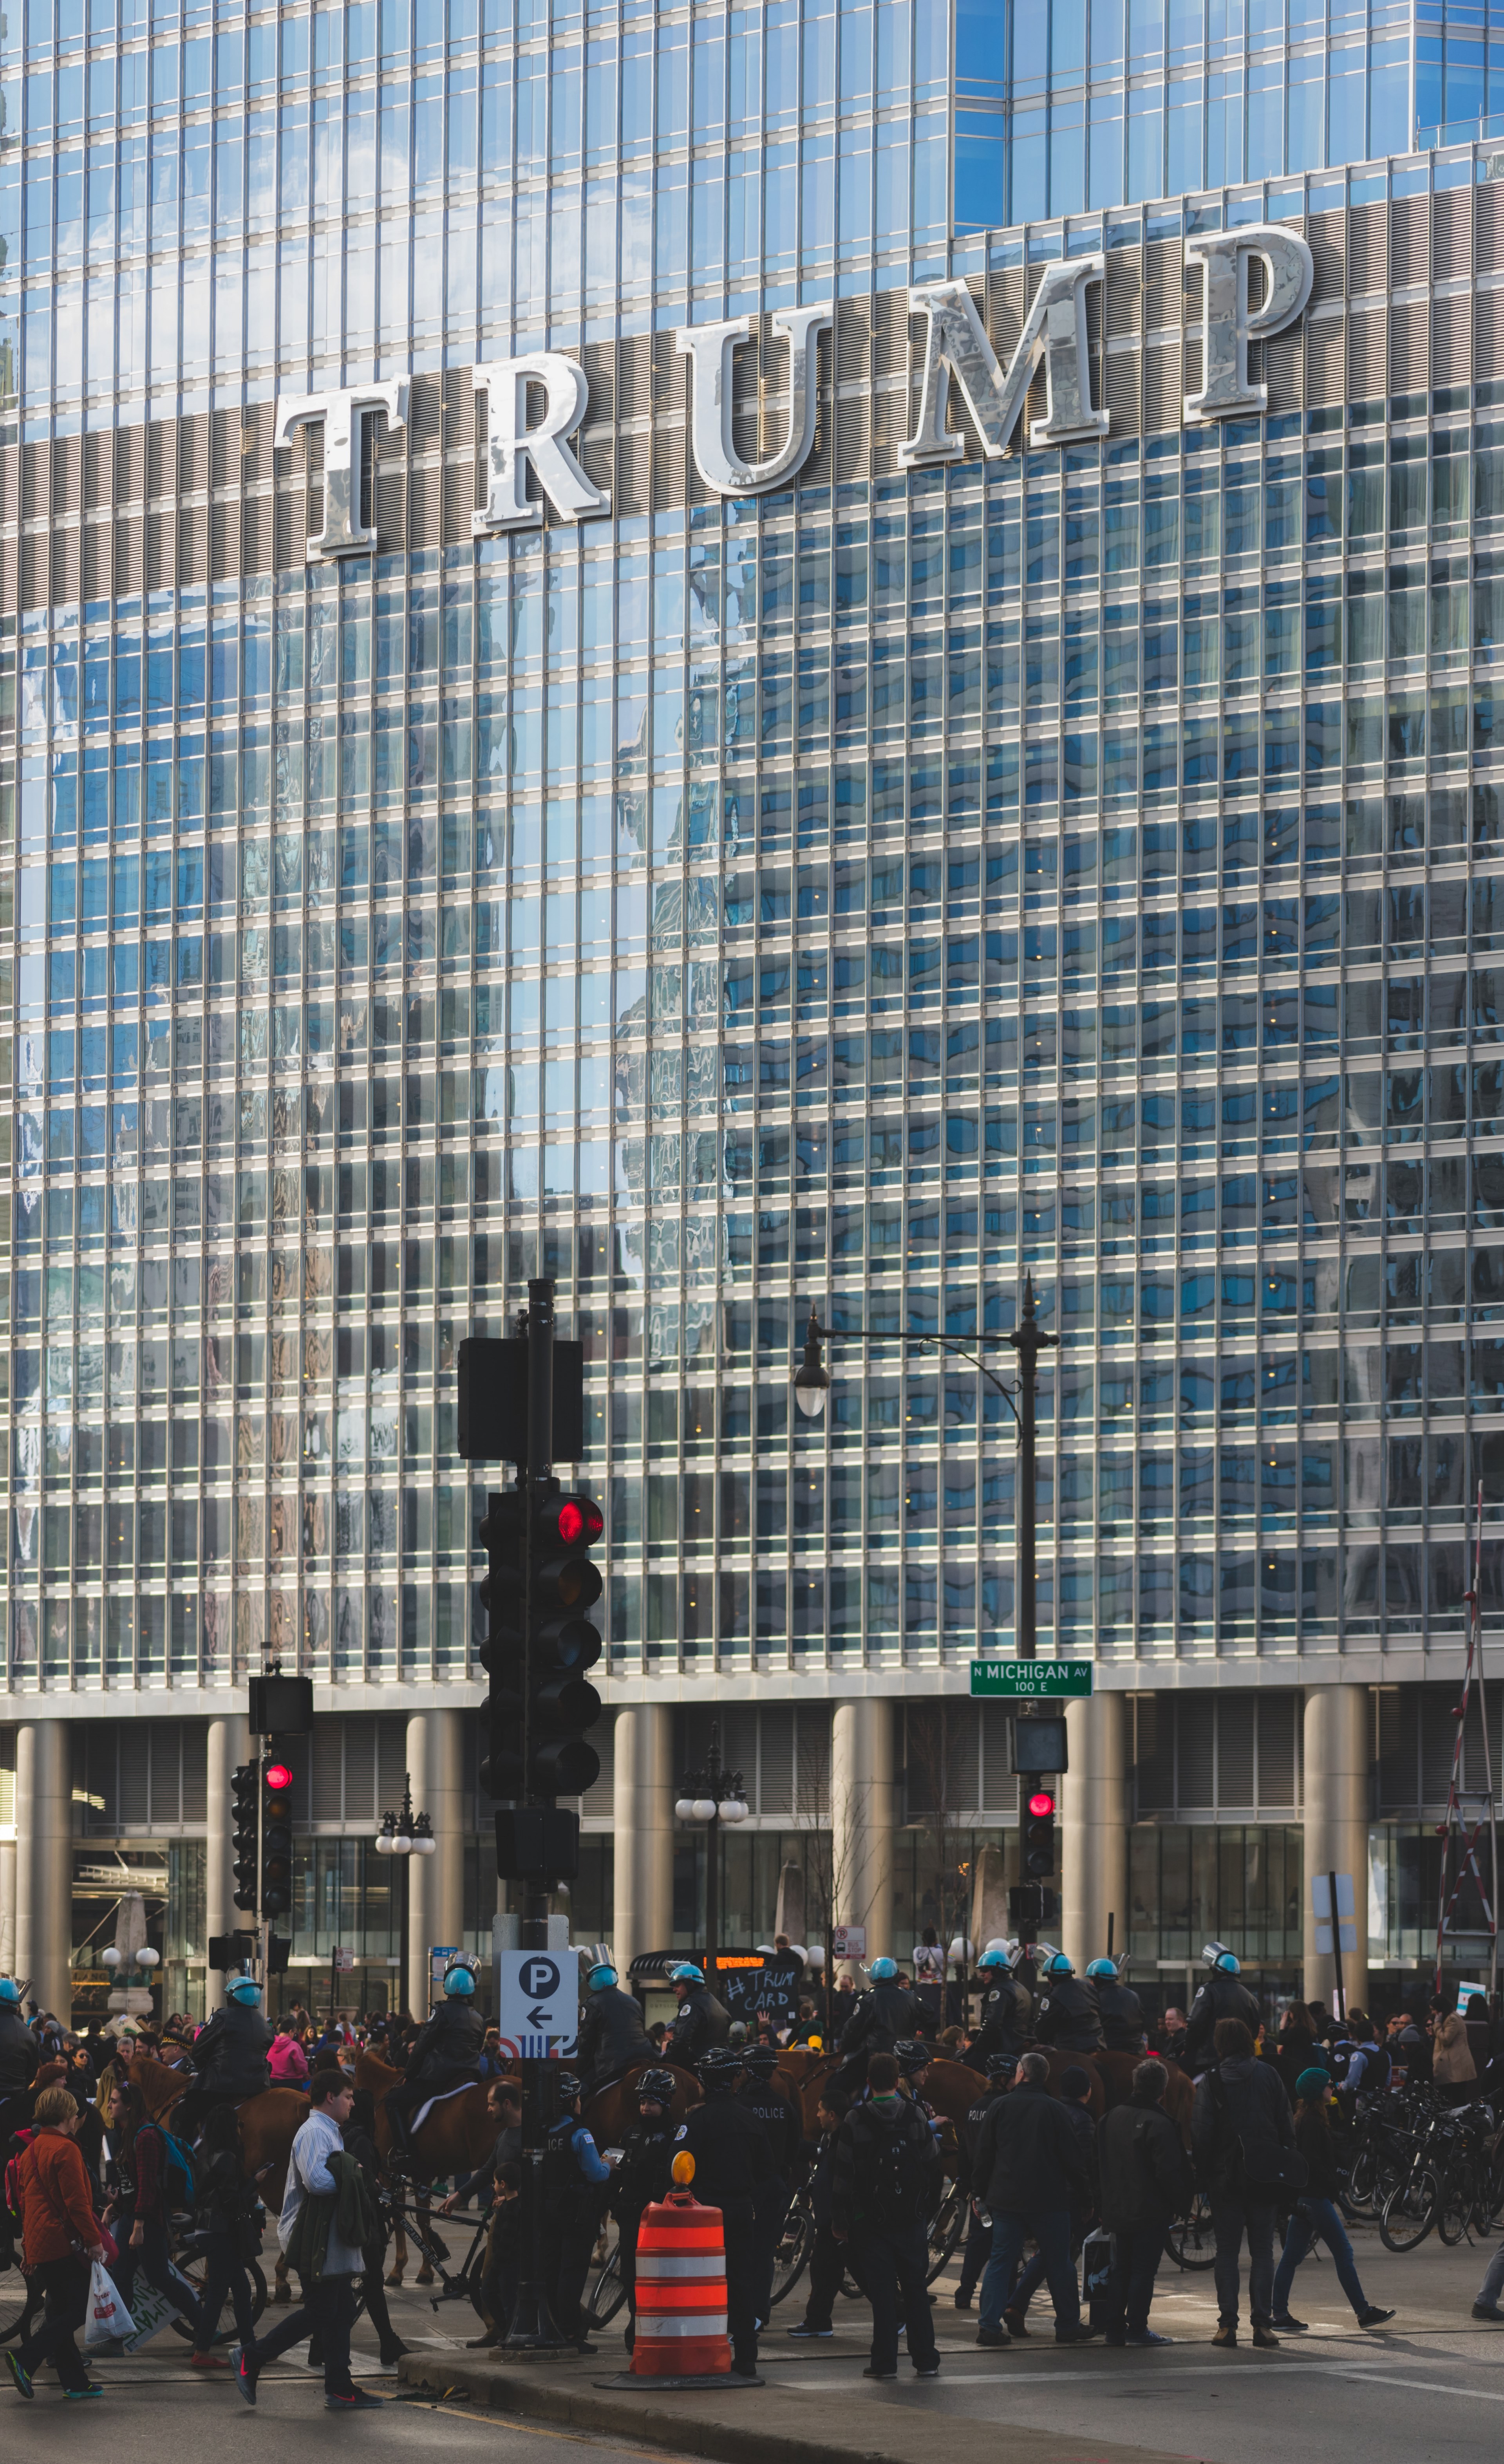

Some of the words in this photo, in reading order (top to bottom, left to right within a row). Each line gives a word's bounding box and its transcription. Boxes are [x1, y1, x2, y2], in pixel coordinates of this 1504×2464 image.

[273, 224, 1314, 561] TRUMP
[974, 1667, 982, 1676] N
[987, 1665, 1068, 1679] MICHIGAN
[1074, 1667, 1088, 1677] AV
[1016, 1682, 1034, 1692] 100
[1041, 1682, 1047, 1691] E
[73, 1973, 107, 1981] LANG
[530, 1964, 552, 1993] P
[748, 1968, 795, 1991] TRUMP
[745, 1992, 788, 2010] CARD
[752, 2107, 784, 2118] POLICE
[968, 2110, 987, 2120] POLIC
[548, 2139, 563, 2151] ICE
[400, 2219, 421, 2244] CHICAGO
[419, 2244, 438, 2266] POLICE
[123, 2294, 176, 2346] LIMATE
